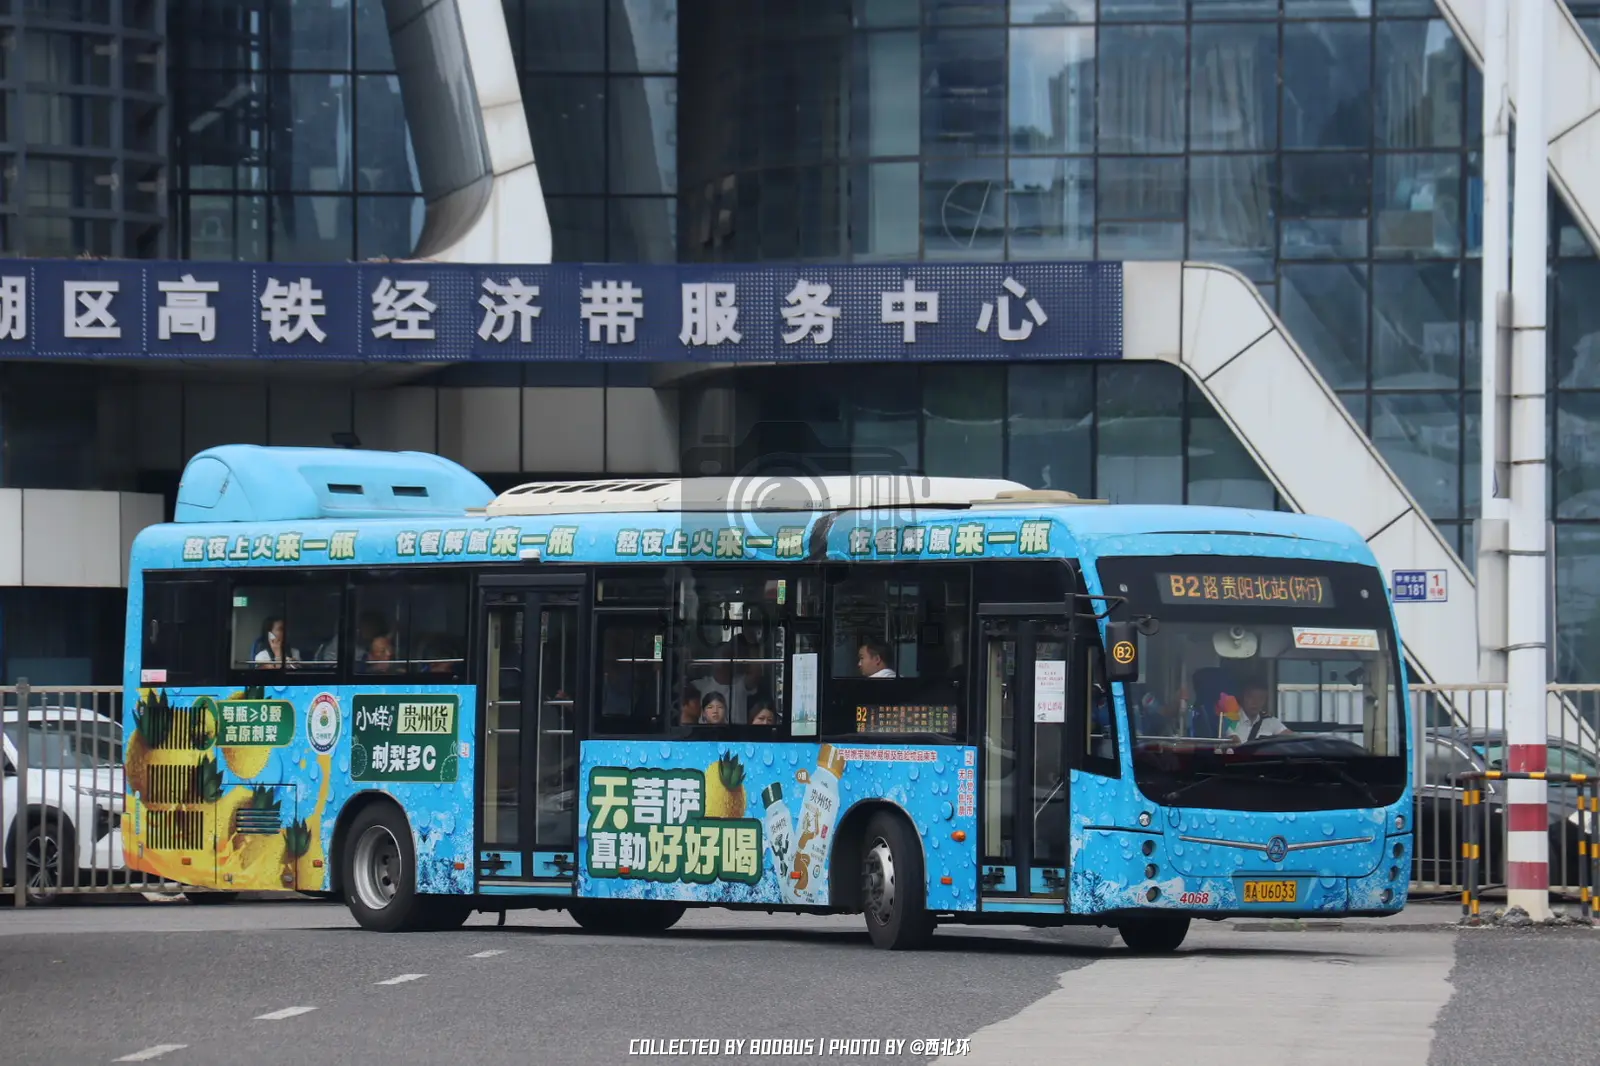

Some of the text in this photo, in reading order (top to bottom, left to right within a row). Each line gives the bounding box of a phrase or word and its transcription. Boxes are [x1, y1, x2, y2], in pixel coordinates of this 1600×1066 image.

[183, 520, 1051, 561] 熬夜上火来一瓶 佐餐解腻来一瓶 熬夜上火来一瓶 佐餐解腻来一瓶
[1408, 584, 1424, 596] 181
[1116, 646, 1132, 659] B2
[223, 705, 282, 722] 每瓶≥8颗
[403, 705, 448, 732] 贵州货
[856, 706, 867, 721] B2
[225, 725, 278, 742] 高原刺梨
[372, 742, 437, 772] 刺梨多C
[592, 776, 700, 829] 天菩萨
[591, 825, 757, 876] 真勒好好喝
[1180, 892, 1209, 904] 4068
